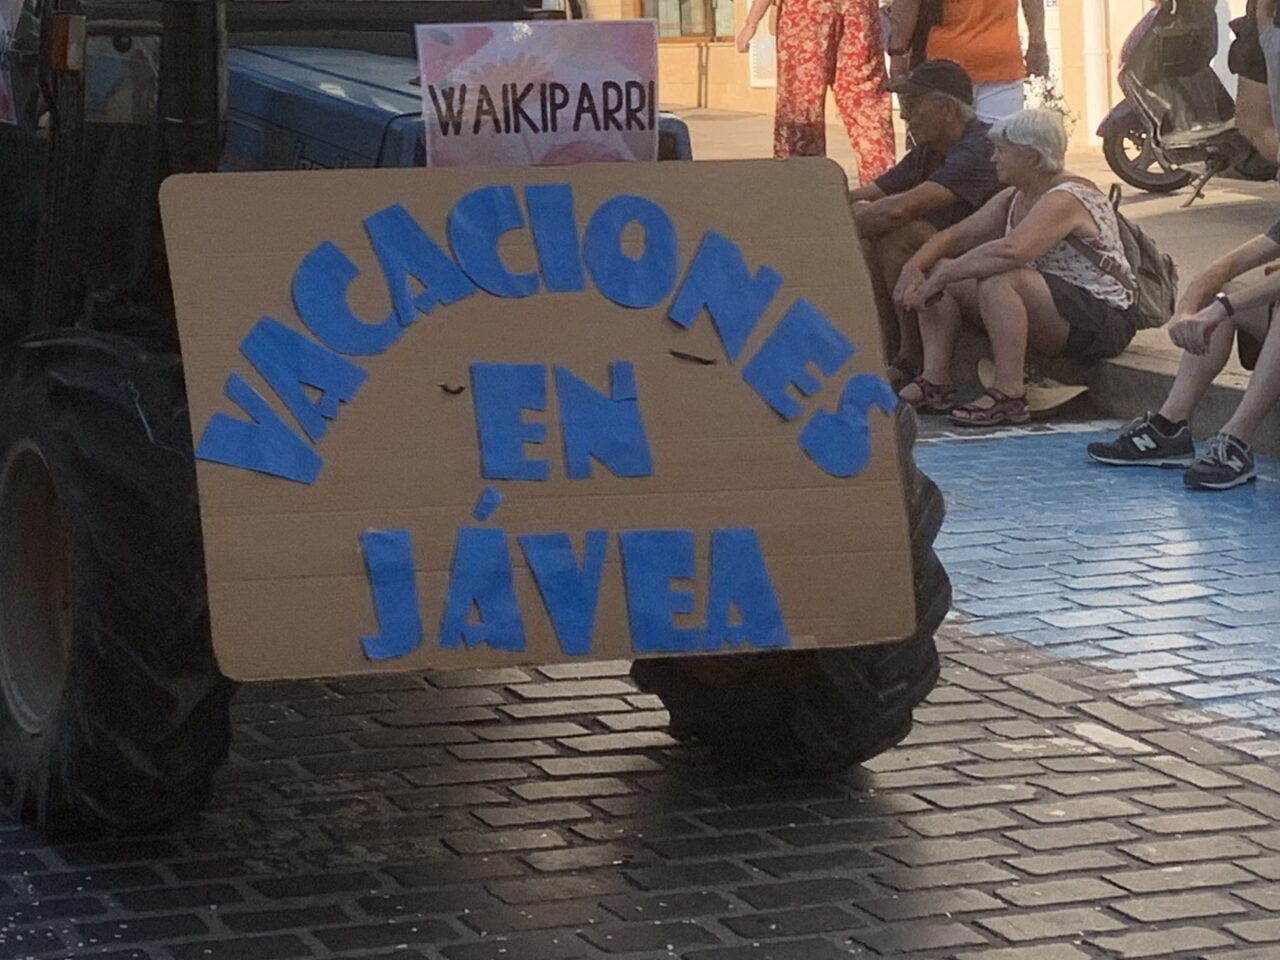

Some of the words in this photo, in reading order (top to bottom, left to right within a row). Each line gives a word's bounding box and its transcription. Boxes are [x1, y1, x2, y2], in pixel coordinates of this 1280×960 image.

[428, 80, 656, 136] WAIKIPARRI
[195, 183, 898, 485] VACACIONES
[469, 361, 654, 481] EN
[360, 486, 791, 661] JÁVEA
